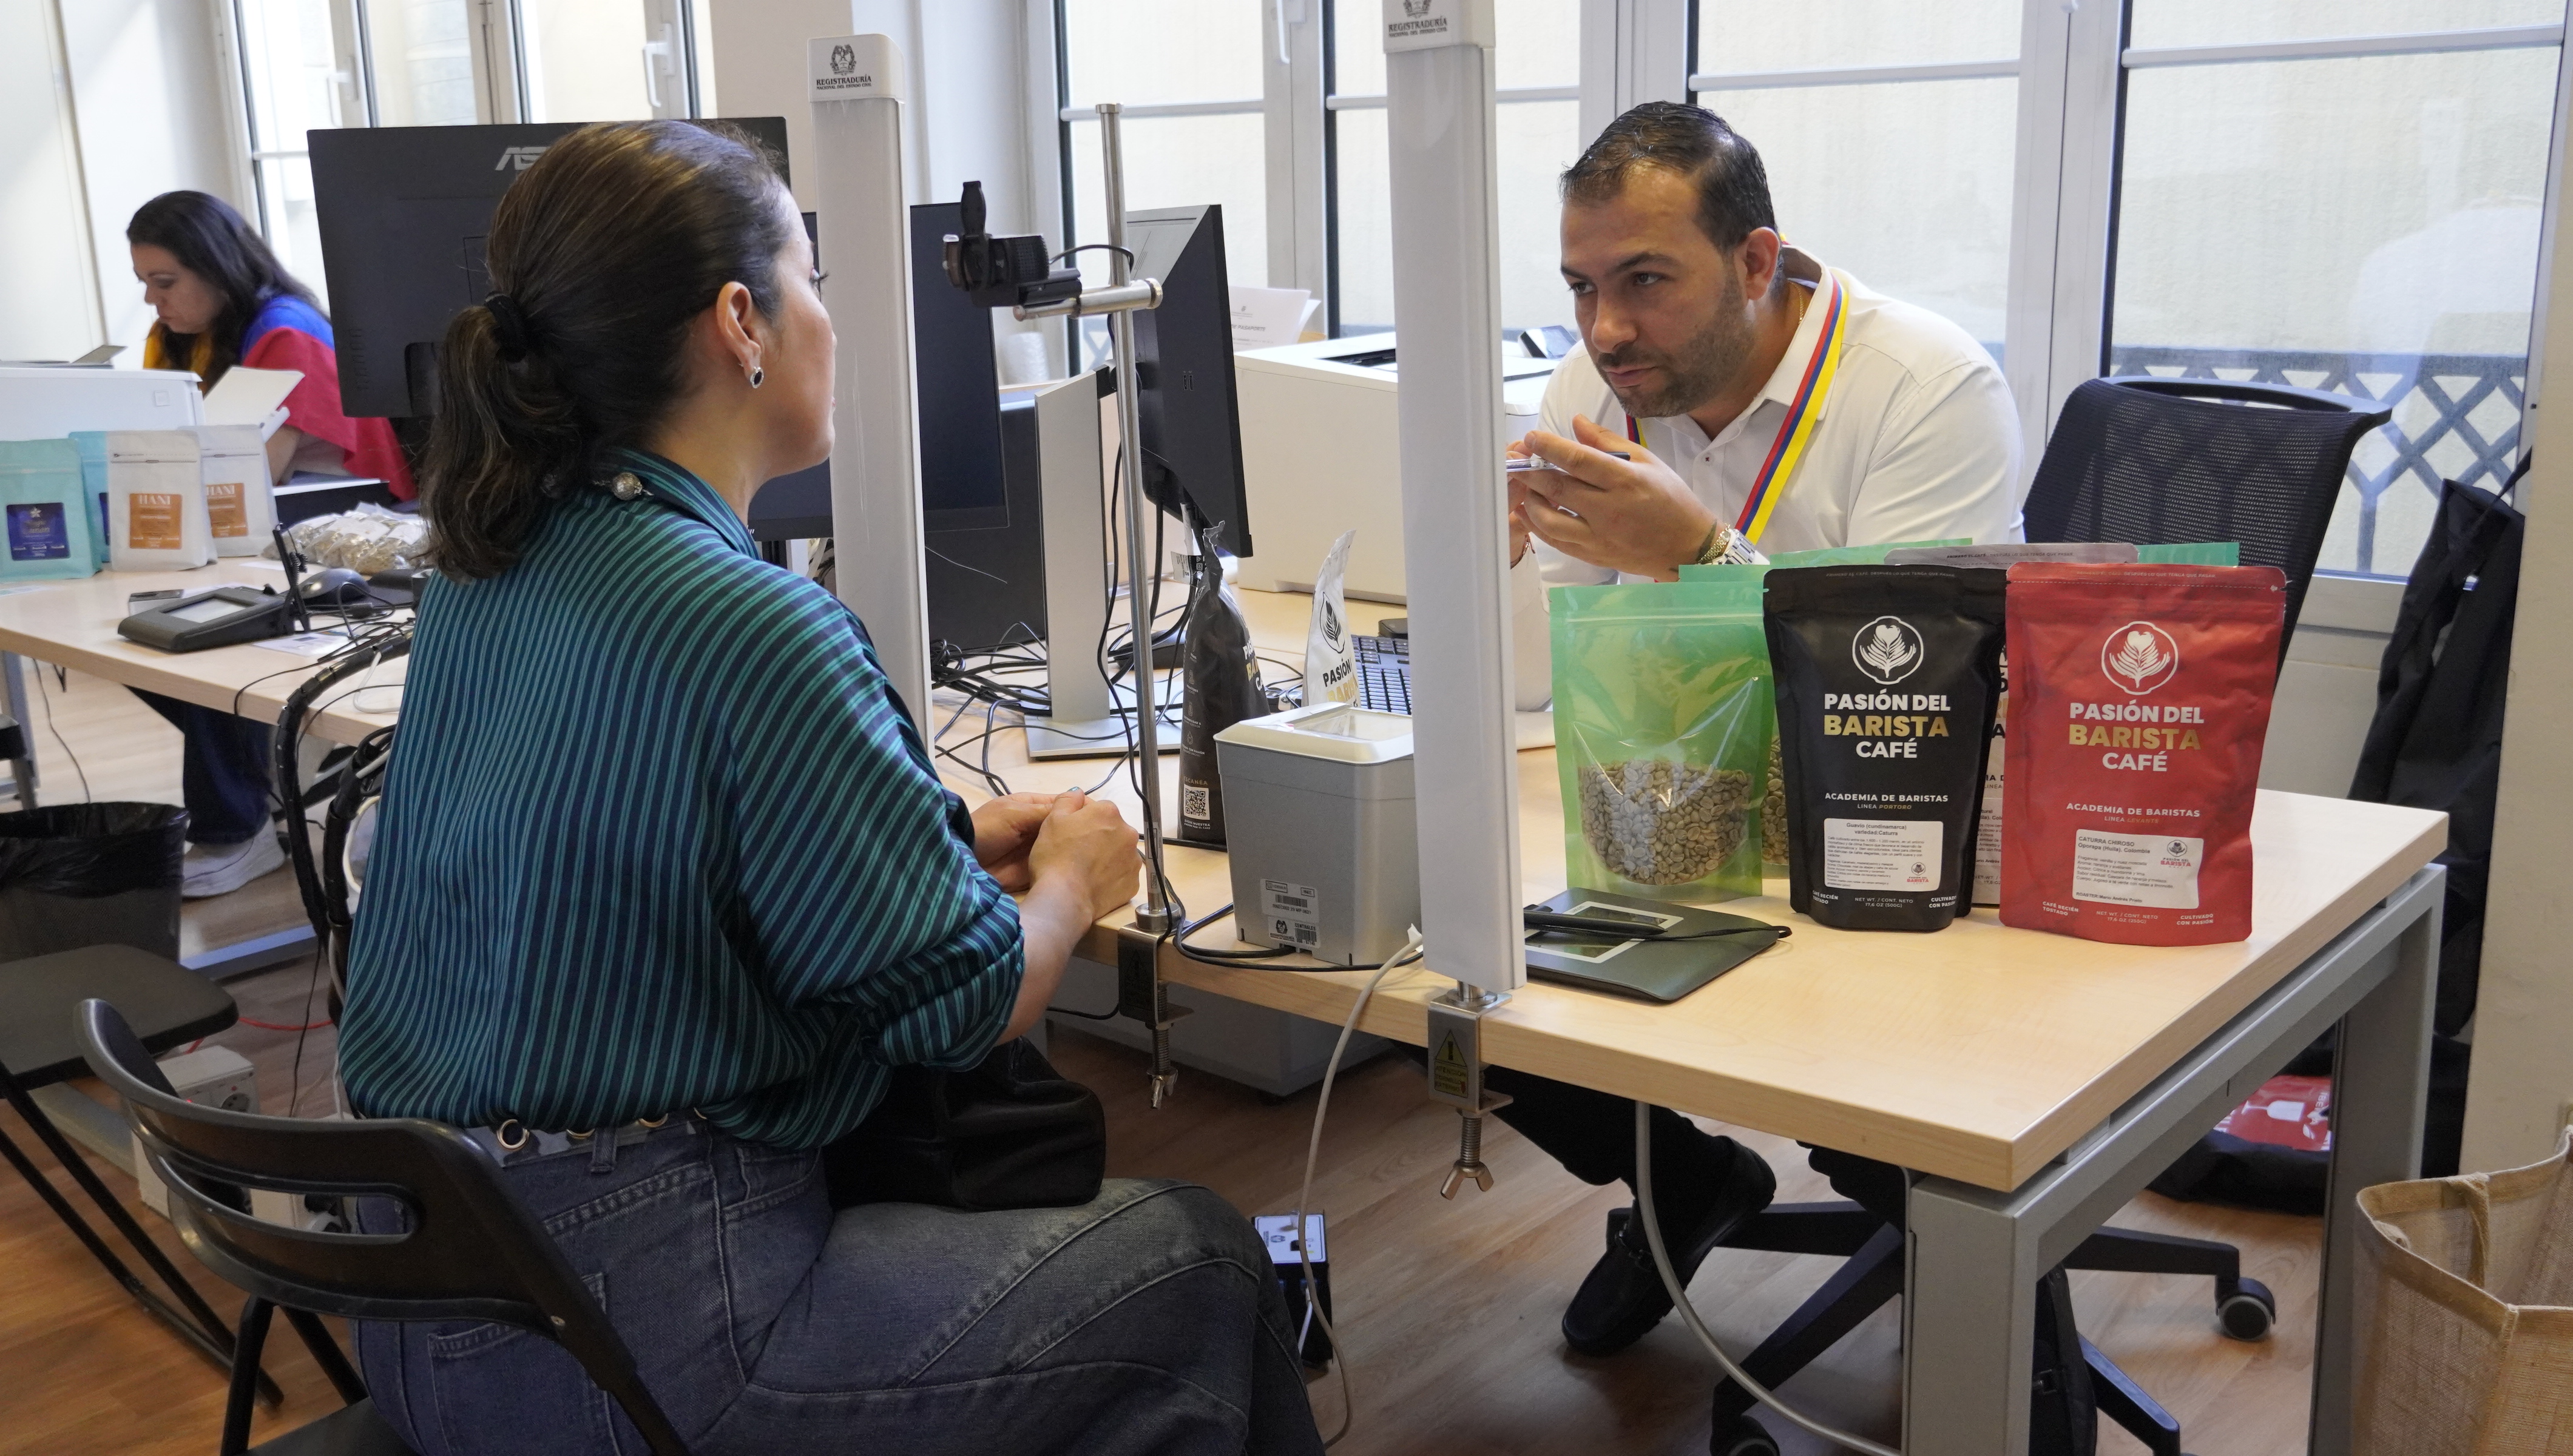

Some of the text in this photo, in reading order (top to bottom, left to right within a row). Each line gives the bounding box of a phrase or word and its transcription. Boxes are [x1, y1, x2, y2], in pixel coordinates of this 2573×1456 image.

[1388, 15, 1447, 32] REGISTRADURÍA
[816, 74, 871, 86] REGISTRADURÍA
[1323, 657, 1351, 687] PASIÓN
[1824, 688, 1950, 711] PASIÓN DEL
[2070, 699, 2204, 724] PASIÓN DEL
[1824, 715, 1949, 736] BARISTA
[2069, 724, 2201, 750] BARISTA
[1856, 738, 1918, 758] CAFÉ
[2102, 750, 2167, 772] CAFÉ
[1825, 793, 1878, 801] ACADEMIA
[2066, 803, 2124, 814] ACADEMIA
[2146, 809, 2200, 817] BARISTAS
[2078, 836, 2106, 844] CATURRA
[2043, 906, 2068, 916] TOSTADO
[2057, 904, 2078, 912] RECIÉN
